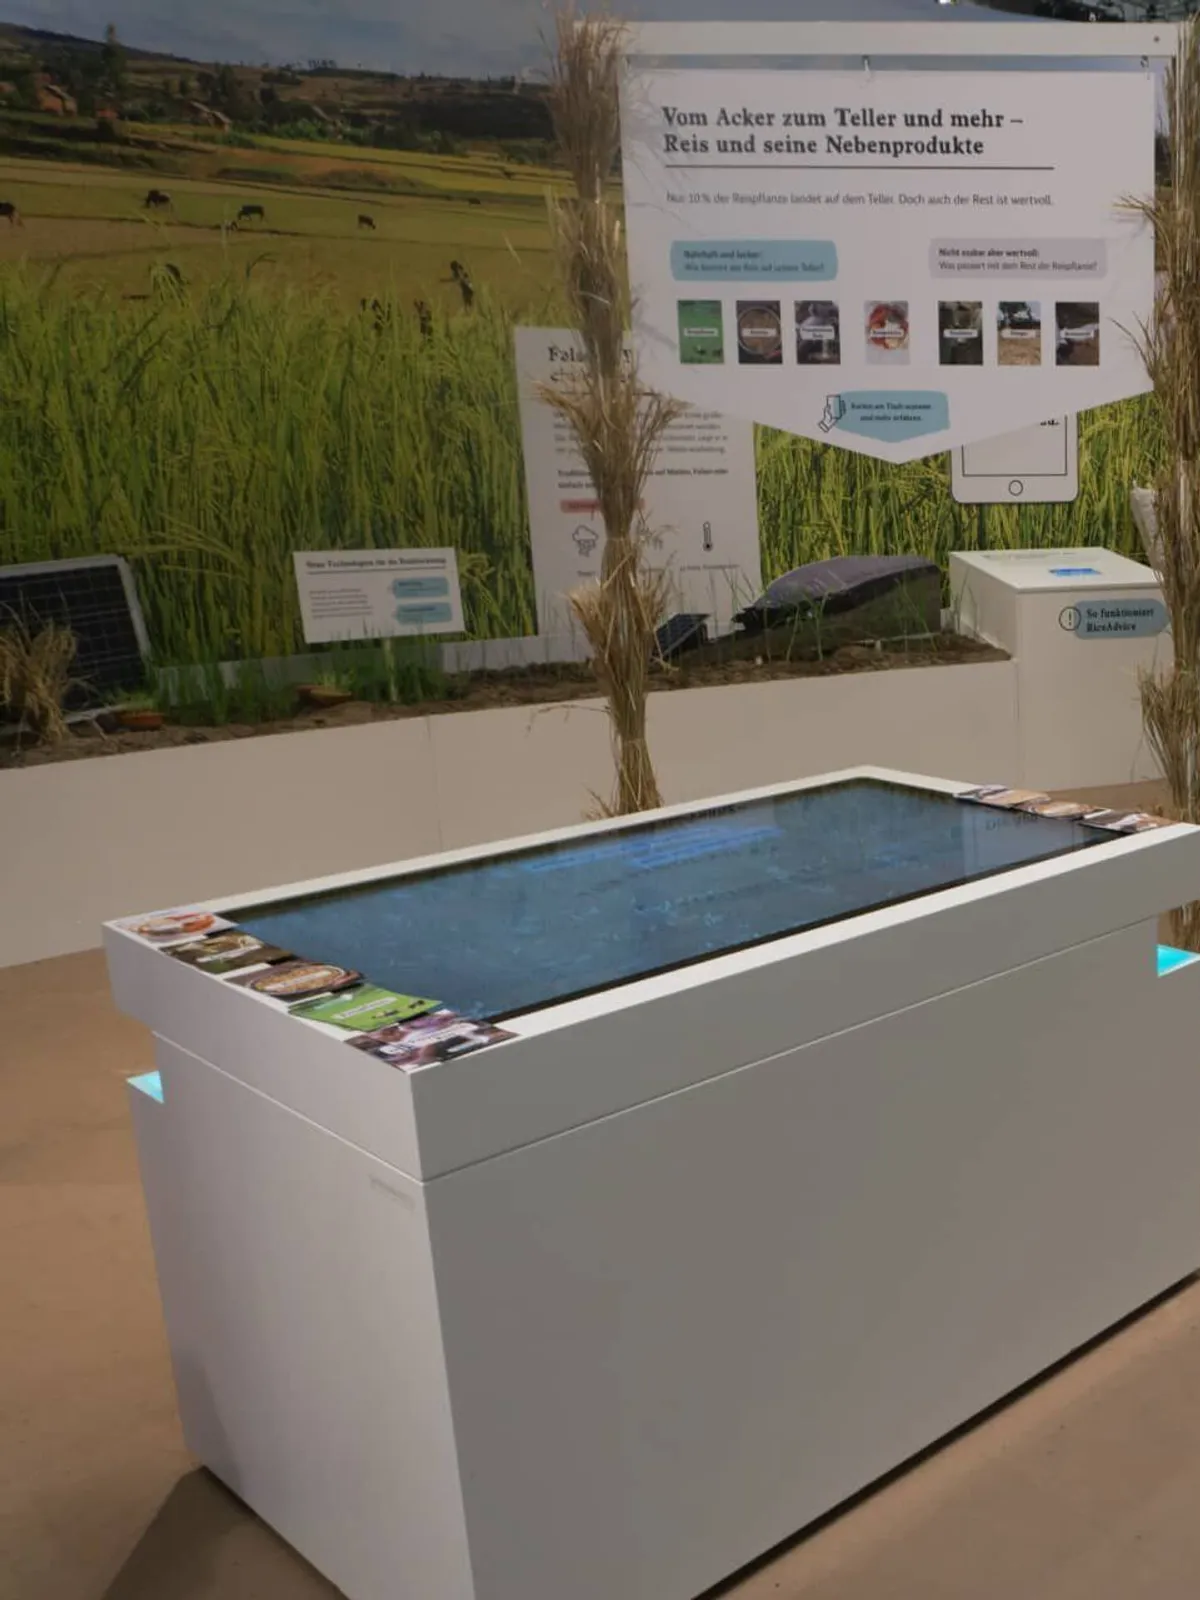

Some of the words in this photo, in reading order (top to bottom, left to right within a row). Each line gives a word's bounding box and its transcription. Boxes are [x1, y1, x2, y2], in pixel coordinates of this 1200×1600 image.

[661, 106, 708, 127] Vom
[716, 107, 775, 127] Acker
[782, 112, 826, 127] zum
[834, 107, 897, 127] Teller
[904, 107, 943, 127] und
[950, 107, 1005, 128] mehr
[663, 134, 709, 153] Reis
[716, 134, 756, 154] und
[763, 135, 817, 154] seine
[825, 135, 985, 158] Nebenprodukte
[714, 191, 730, 204] der
[790, 191, 822, 204] landet
[825, 190, 839, 204] auf
[842, 191, 866, 204] dem
[898, 191, 925, 204] Doch
[928, 191, 951, 204] auch
[953, 191, 969, 204] der
[972, 191, 993, 204] Rest
[996, 191, 1008, 204] ist
[1086, 607, 1098, 618] So
[1100, 606, 1155, 619] funktioniert
[1086, 620, 1137, 633] RiceAdvice
